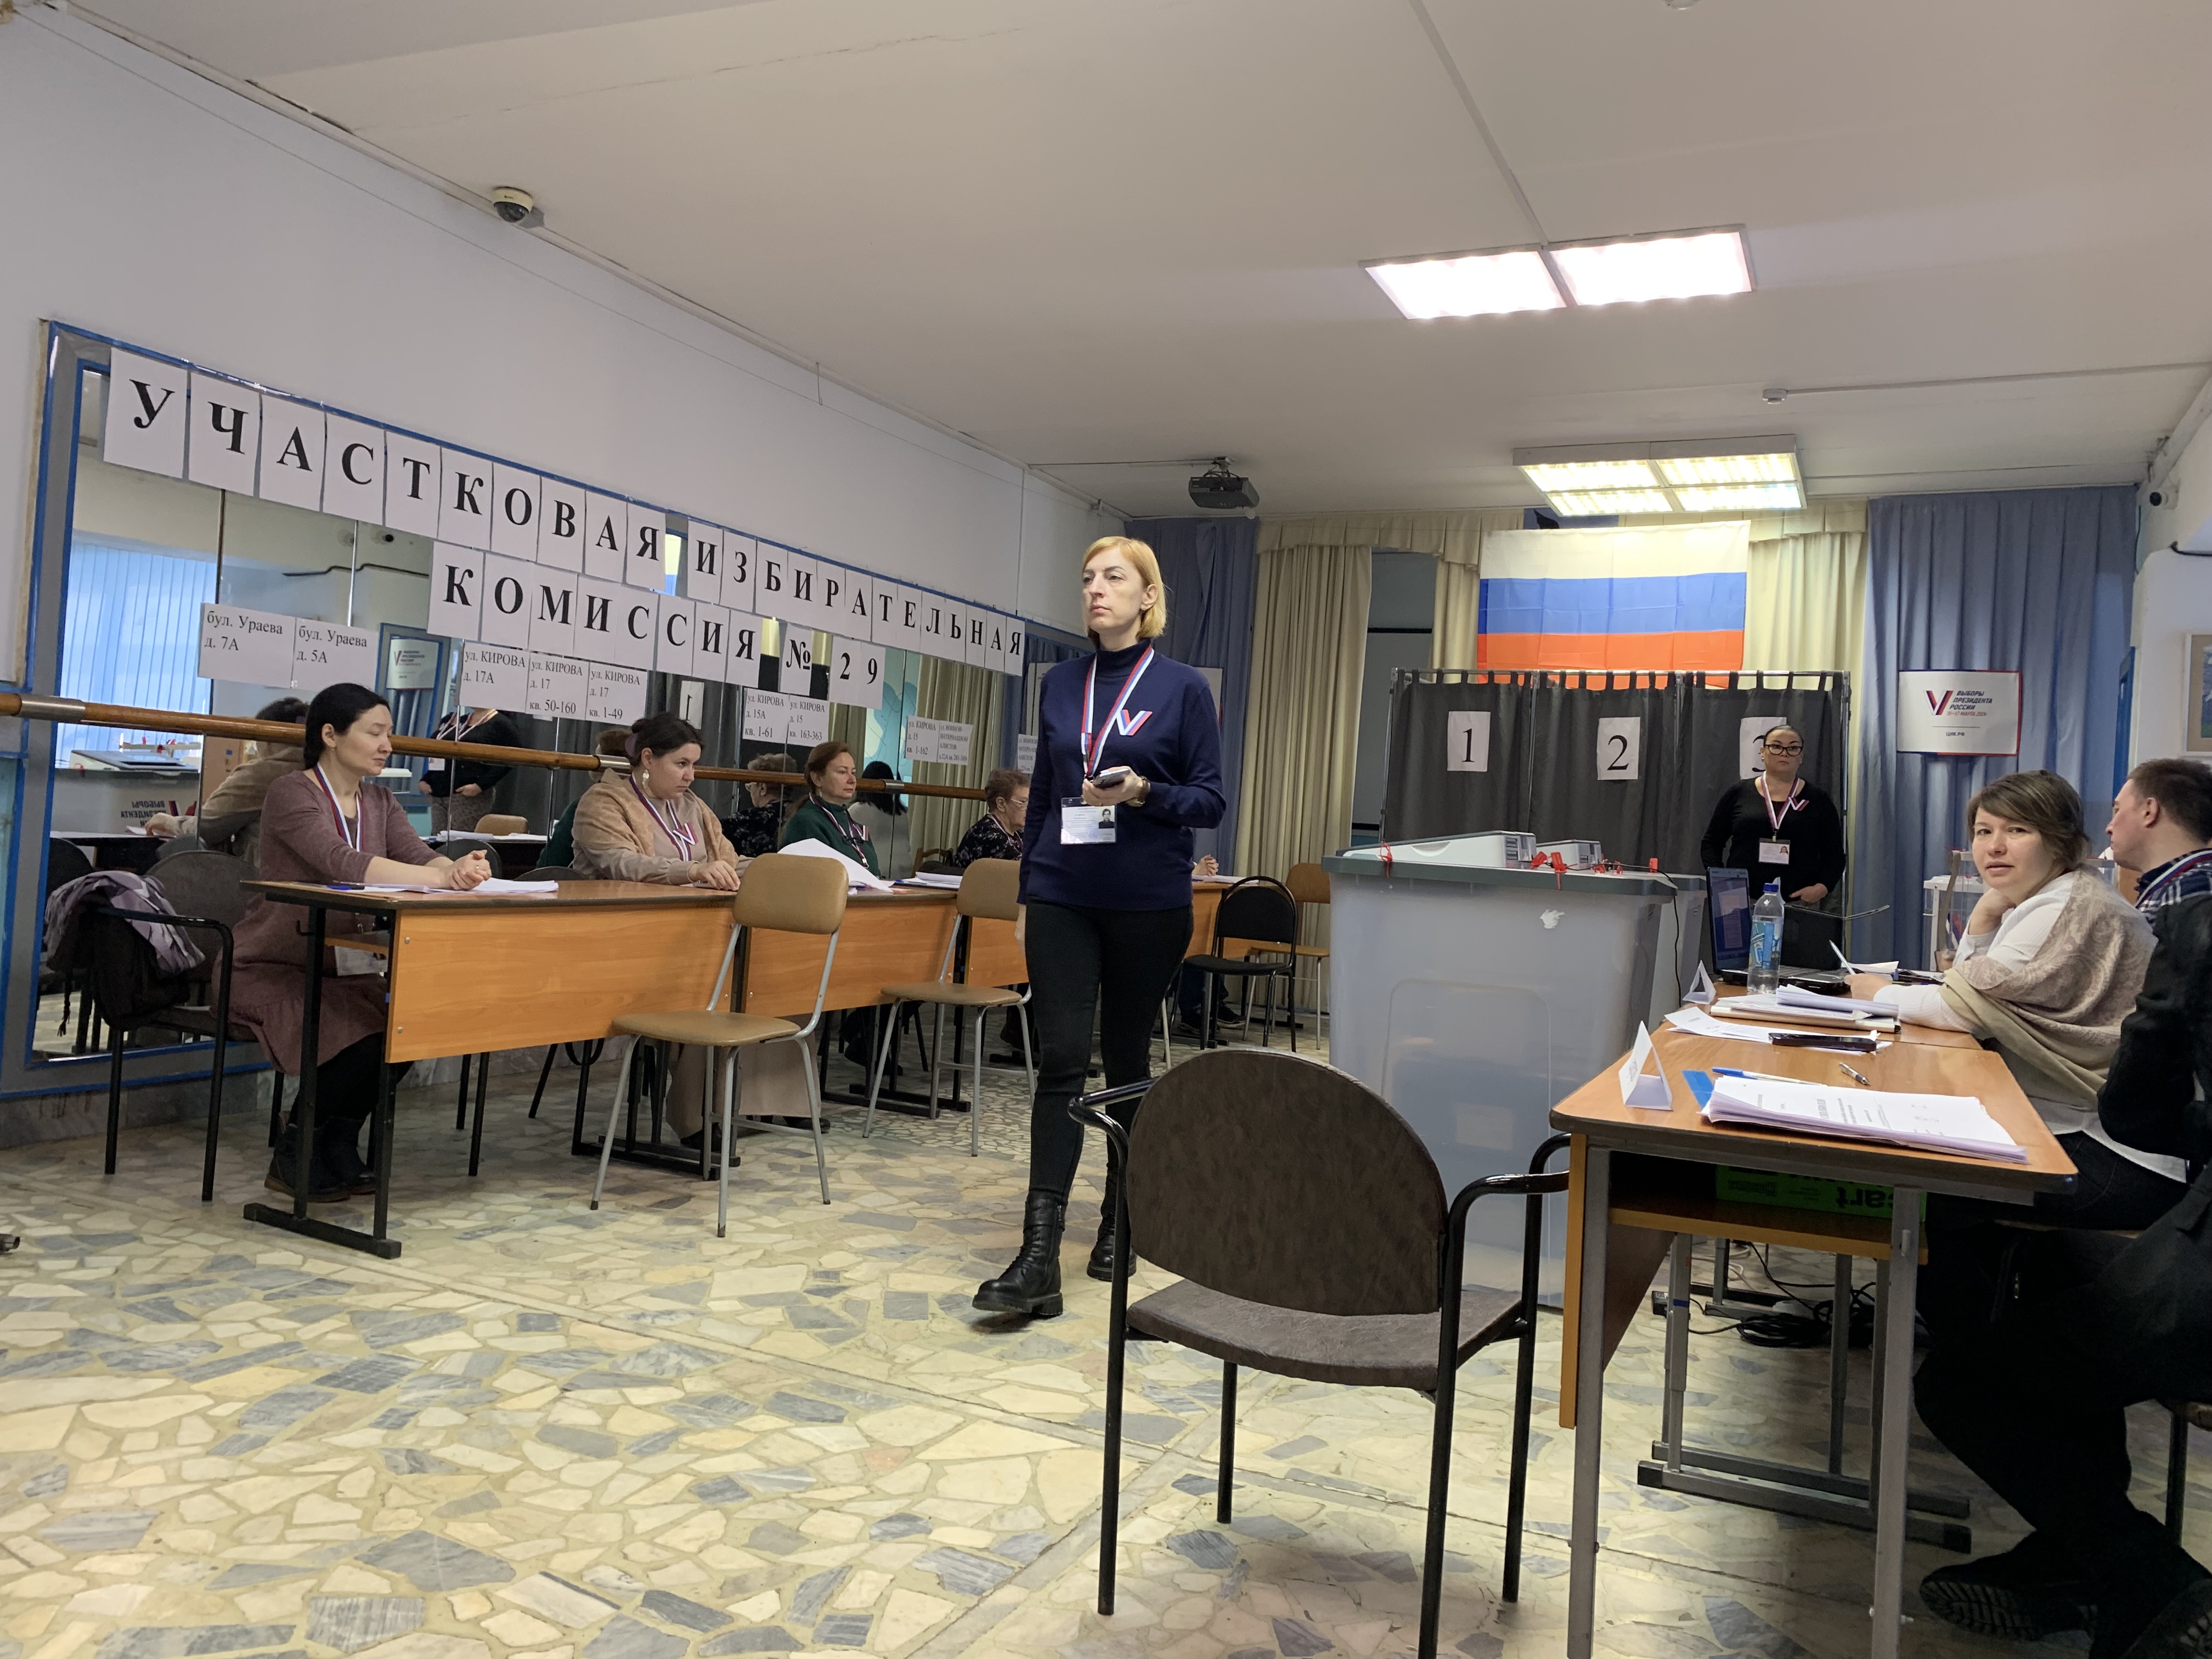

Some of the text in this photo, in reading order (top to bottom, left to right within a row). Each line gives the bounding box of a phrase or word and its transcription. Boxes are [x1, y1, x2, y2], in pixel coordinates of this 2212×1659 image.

[129, 379, 1022, 656] УЧАСТКОВАЯ ИЗБИРАТЕЛЬНАЯ
[207, 611, 283, 634] бул. Ураева
[443, 565, 756, 661] КОМИССИЯ
[786, 639, 811, 670] №
[840, 652, 878, 685] 29
[299, 625, 367, 647] бул. Ураева
[204, 636, 239, 651] д. 7А
[296, 650, 328, 663] д. 5А
[465, 651, 526, 668] ул. КИРОВА
[531, 661, 583, 676] ул. КИРОВА
[463, 670, 494, 684] д. 17А
[590, 669, 640, 685] ул. КИРОВА
[541, 679, 550, 689] 17
[600, 687, 609, 697] 17
[529, 699, 576, 714] кв. 50-160
[758, 695, 784, 707] КИРОВА
[800, 701, 825, 713] КИРОВА
[589, 707, 623, 720] кв. 1-49
[754, 709, 766, 719] 15А
[797, 714, 803, 724] 15
[745, 726, 772, 738] кв. 1-61
[916, 721, 936, 731] КИРОВА
[800, 730, 822, 740] 163-363
[916, 746, 928, 755] 1-162
[1462, 728, 1476, 763] 1
[1607, 735, 1629, 771] 2
